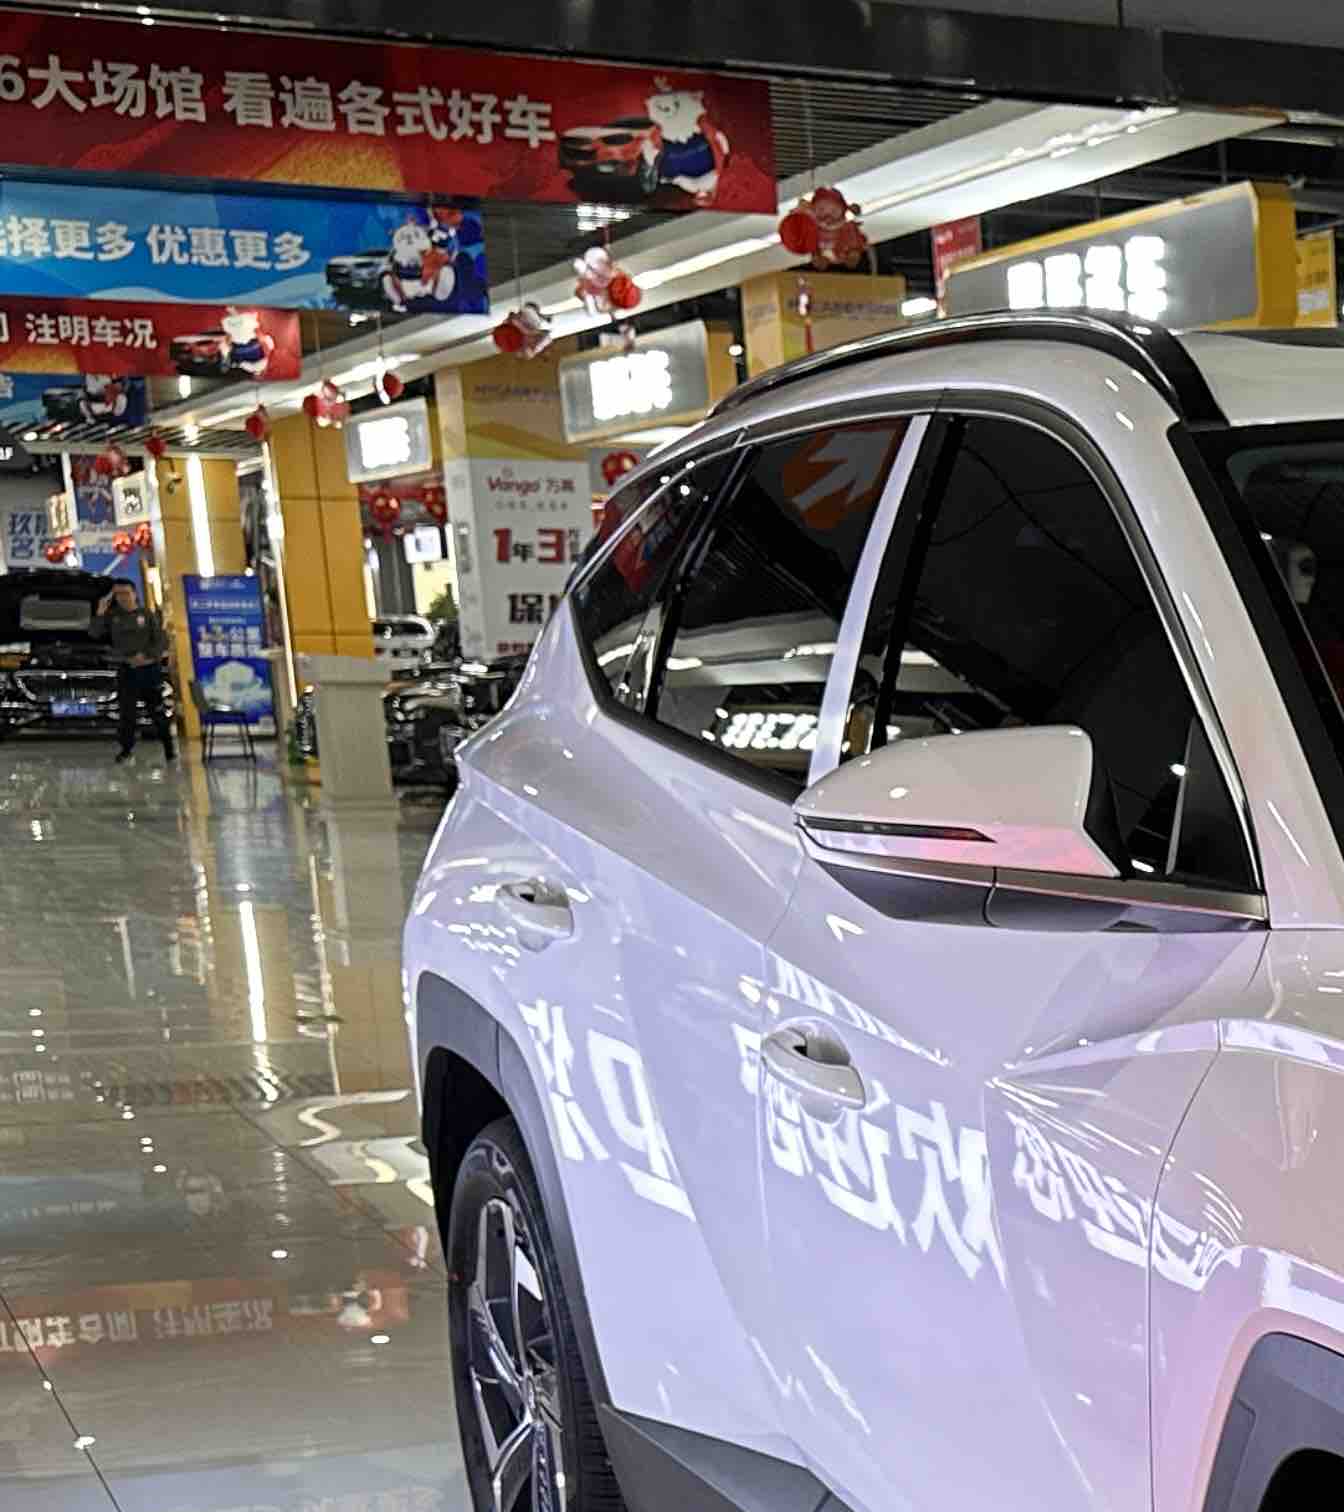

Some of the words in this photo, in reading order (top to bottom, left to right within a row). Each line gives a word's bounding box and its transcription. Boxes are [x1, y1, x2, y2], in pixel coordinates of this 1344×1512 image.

[222, 71, 557, 148] 看遍各式好车
[0, 215, 135, 260] 择更多
[146, 224, 311, 270] 优惠更多
[25, 312, 157, 349] 注明车况
